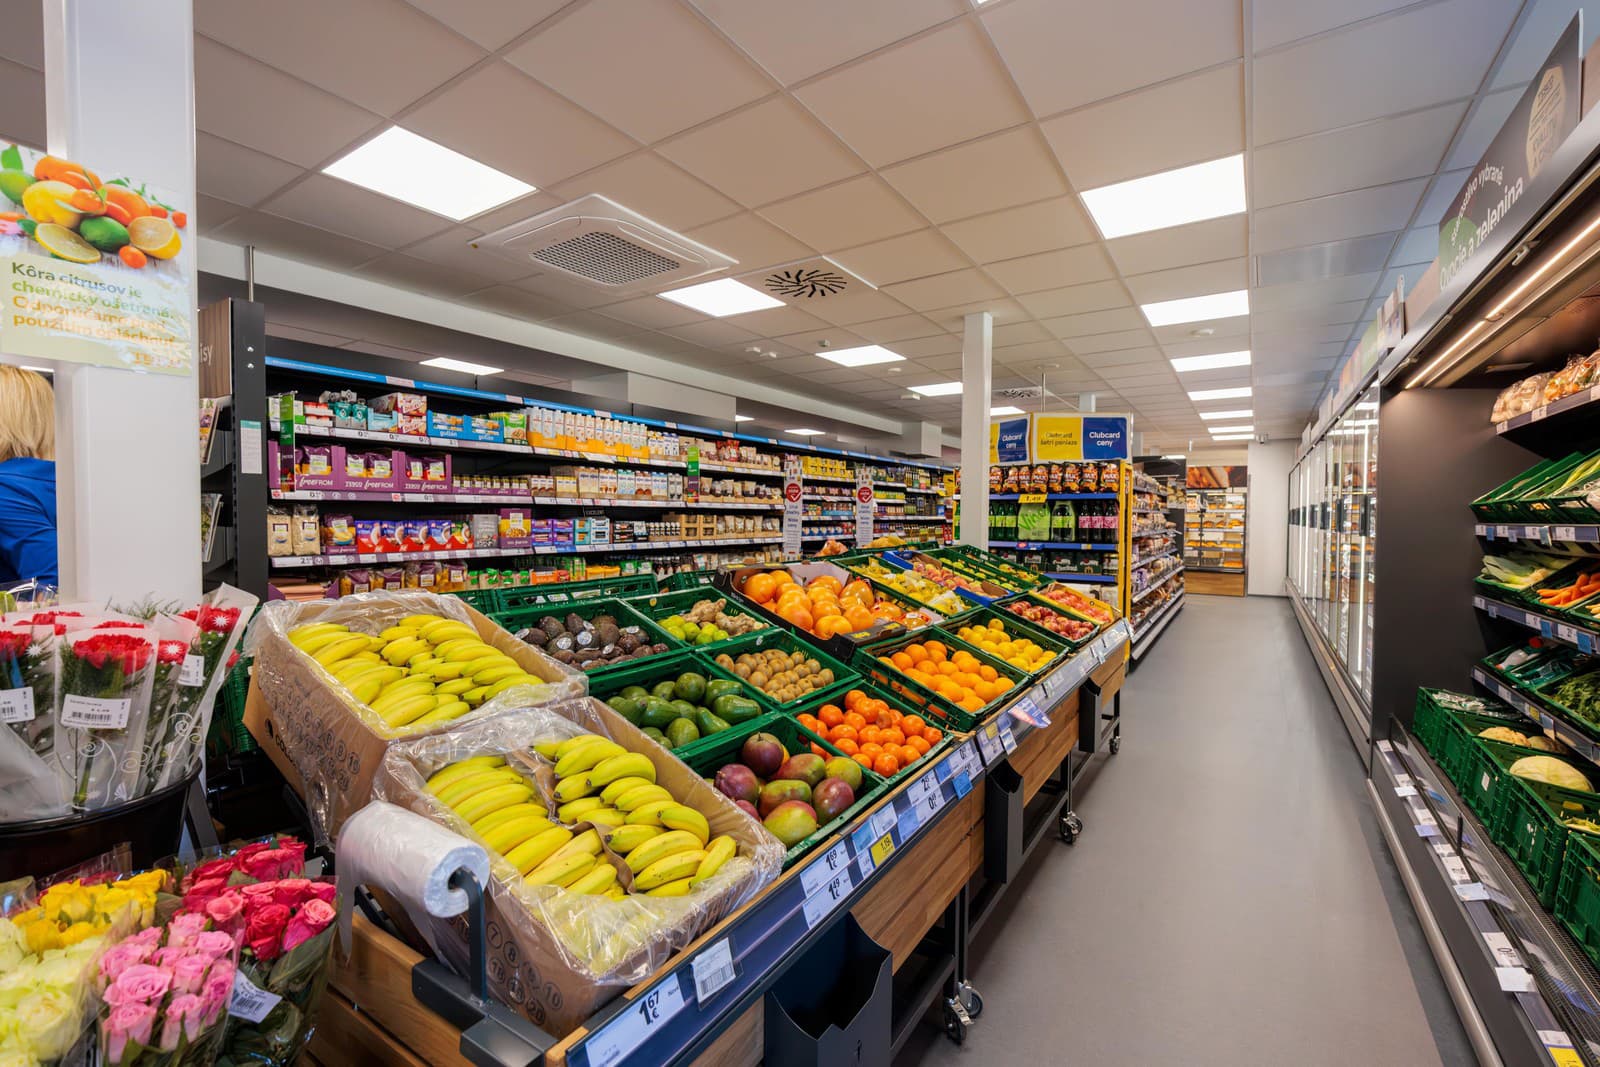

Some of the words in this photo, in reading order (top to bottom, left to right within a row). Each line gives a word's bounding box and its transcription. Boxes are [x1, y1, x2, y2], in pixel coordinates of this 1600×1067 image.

[1476, 177, 1524, 249] zelenina
[12, 262, 55, 282] Kôra
[59, 274, 126, 295] citrusov
[1088, 431, 1120, 439] Clubcard
[1096, 440, 1113, 448] ceny
